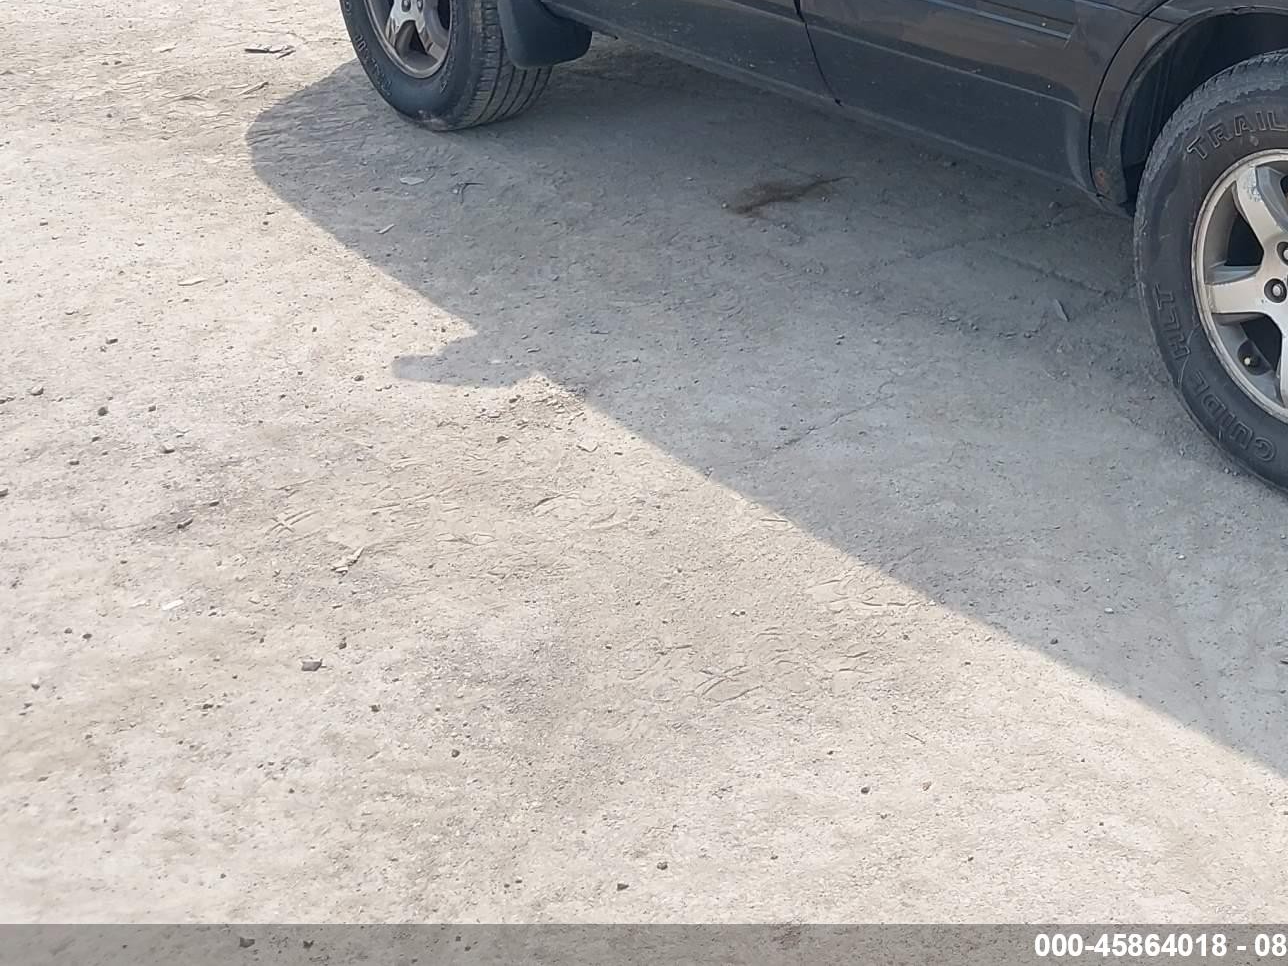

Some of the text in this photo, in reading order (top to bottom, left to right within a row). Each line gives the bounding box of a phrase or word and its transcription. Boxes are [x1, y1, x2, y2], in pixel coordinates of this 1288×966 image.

[1186, 109, 1288, 160] TRAIL
[1154, 282, 1192, 361] HLT
[1192, 369, 1278, 462] GUIDE
